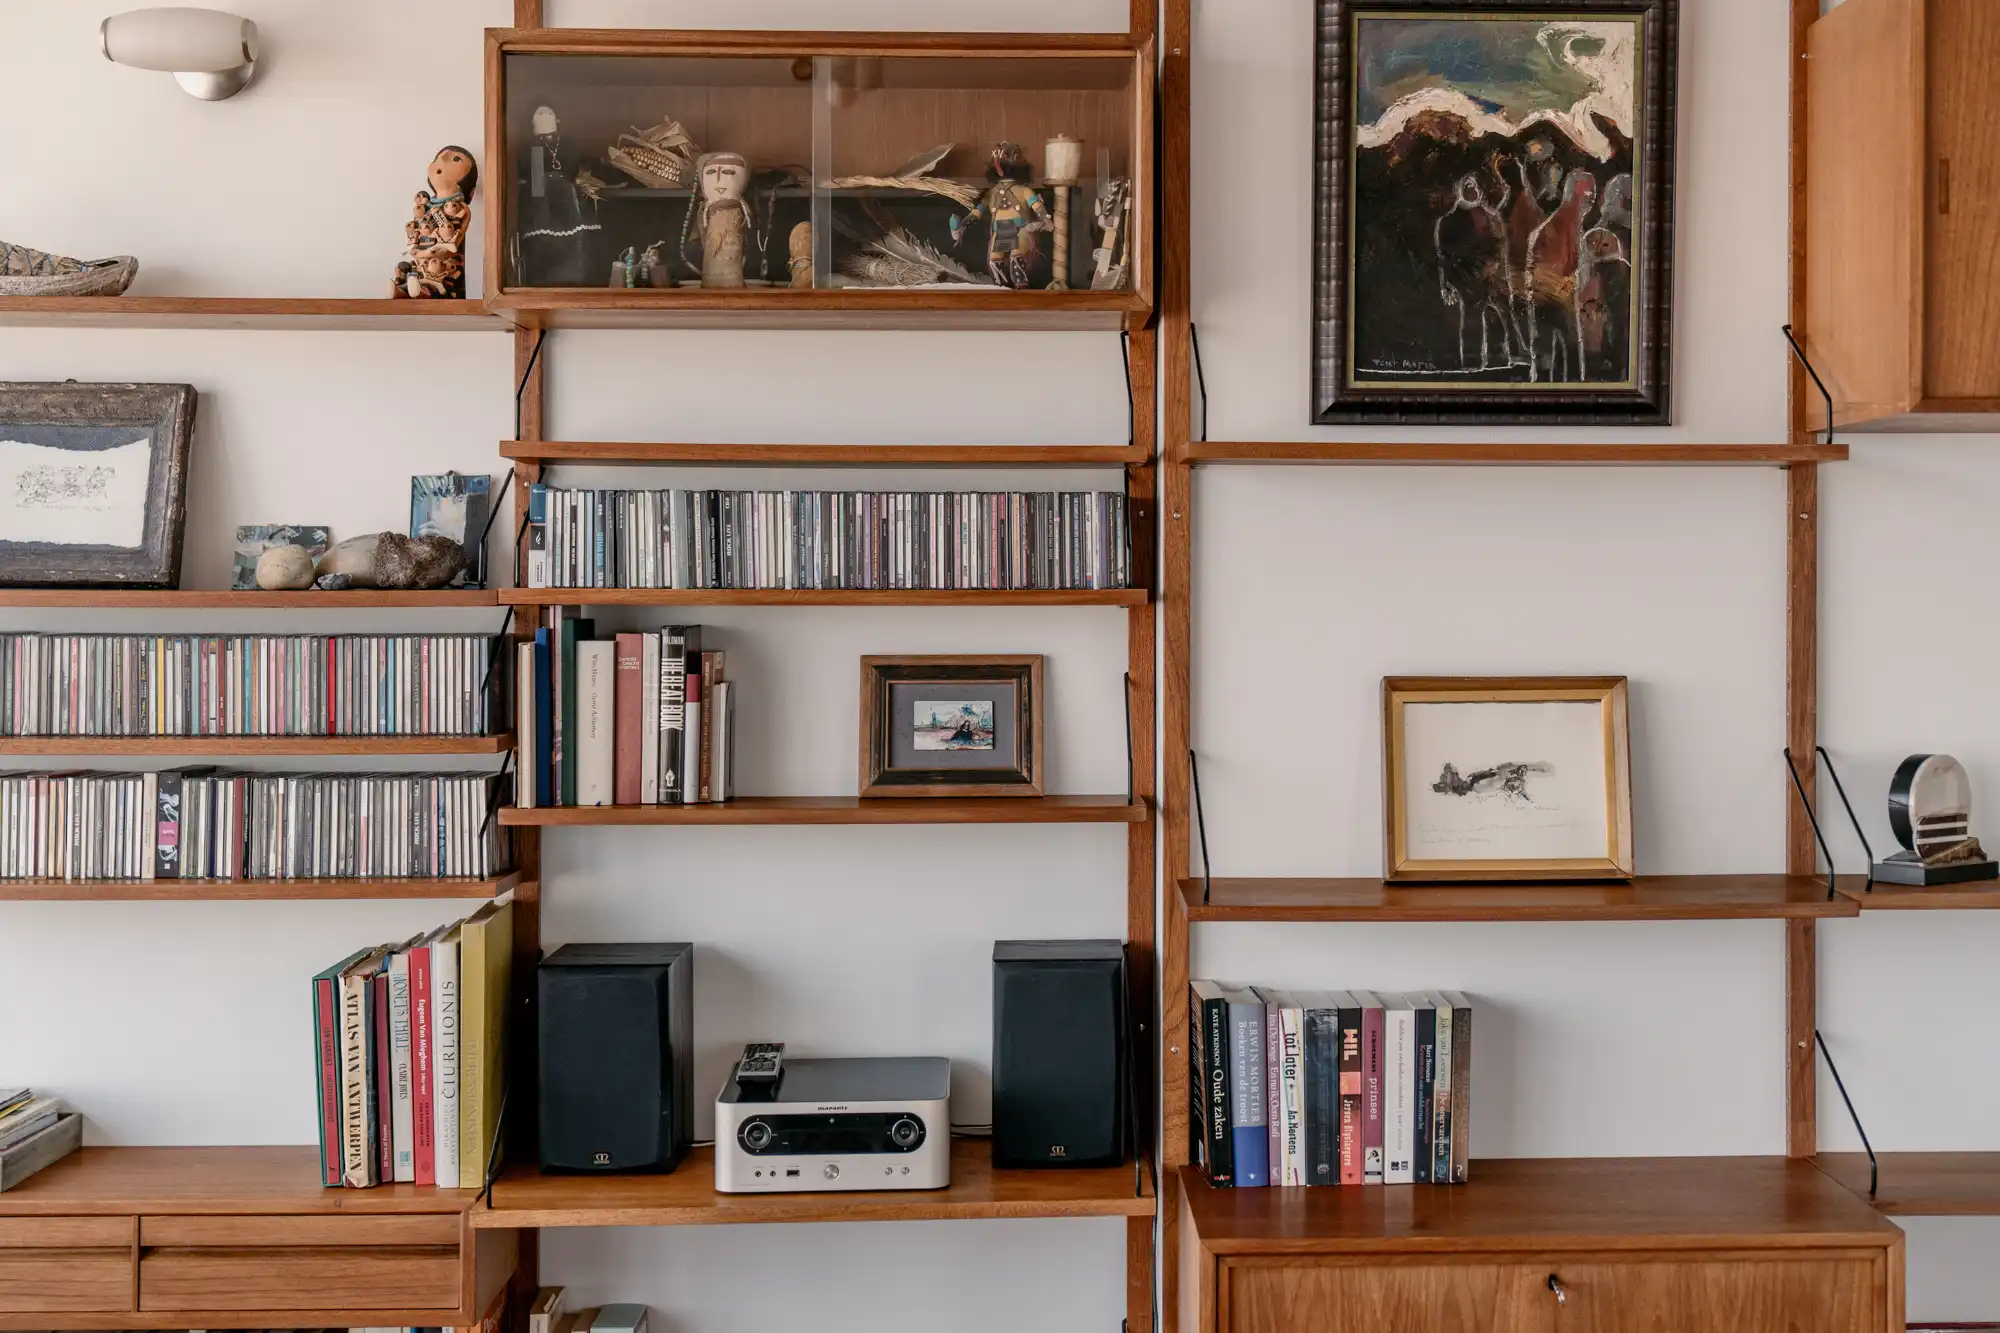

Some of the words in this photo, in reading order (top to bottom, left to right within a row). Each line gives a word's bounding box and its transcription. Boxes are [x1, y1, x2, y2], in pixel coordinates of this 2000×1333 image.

[661, 657, 684, 675] THE
[661, 676, 683, 702] BEAT
[590, 710, 598, 739] Achterberg
[660, 705, 683, 731] BOOK
[346, 991, 360, 1041] ATLAS
[418, 999, 426, 1024] Eugeen
[1439, 1016, 1449, 1035] Joke
[394, 1019, 409, 1053] TABLE
[419, 1025, 427, 1038] Van
[440, 980, 456, 1099] ČIURLIONIS
[1238, 1021, 1247, 1057] Boeken
[1248, 1021, 1259, 1063] ERWIN
[1285, 1032, 1297, 1049] tot
[1343, 1028, 1358, 1061] WIL
[347, 1045, 361, 1073] VAN
[418, 1039, 427, 1071] Mieghem
[1213, 1028, 1221, 1066] ATKINSON
[1268, 1037, 1279, 1062] Jonge
[398, 1063, 406, 1084] CLAIRE
[1285, 1053, 1299, 1080] later
[1440, 1052, 1448, 1088] Leeuwen
[1213, 1069, 1225, 1103] Oude
[1239, 1079, 1247, 1091] de
[1250, 1066, 1260, 1123] MORTIER
[1368, 1077, 1378, 1120] prinses
[1439, 1092, 1447, 1104] De
[347, 1079, 362, 1172] ANTWERPEN
[1214, 1106, 1225, 1140] zaken
[1288, 1110, 1297, 1121] An
[1343, 1099, 1354, 1124] Jeroen
[1271, 1120, 1280, 1138] Rafi
[1288, 1123, 1298, 1155] Mertens
